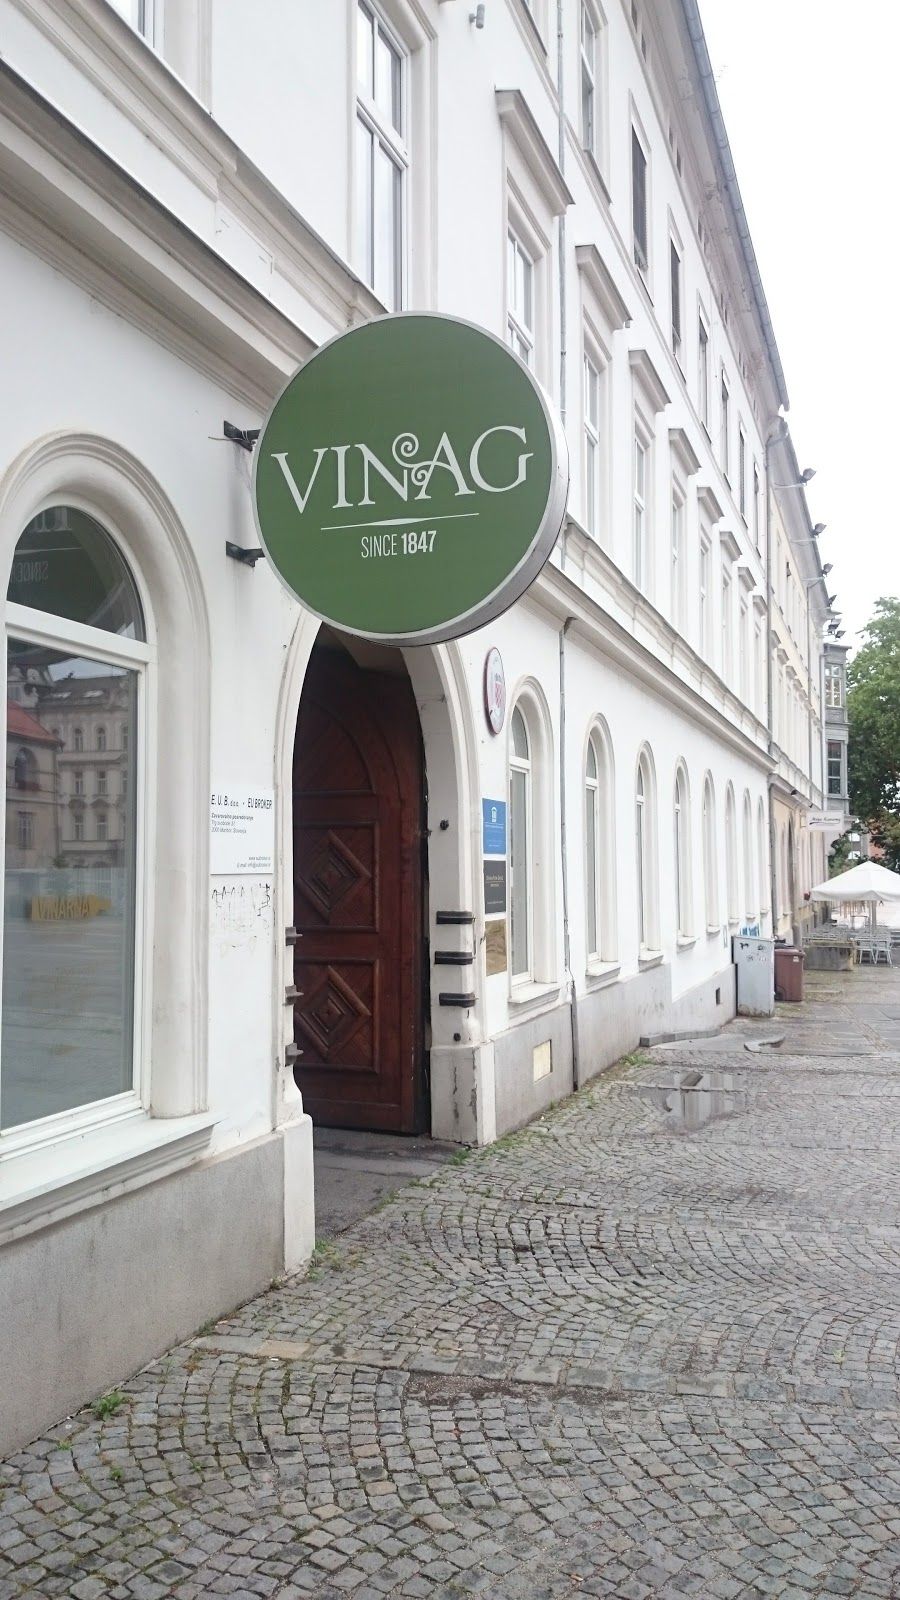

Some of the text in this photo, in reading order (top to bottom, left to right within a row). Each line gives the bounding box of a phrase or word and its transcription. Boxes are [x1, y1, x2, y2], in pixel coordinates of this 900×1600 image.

[270, 425, 534, 514] VINAG
[360, 530, 437, 558] SINCE 1847
